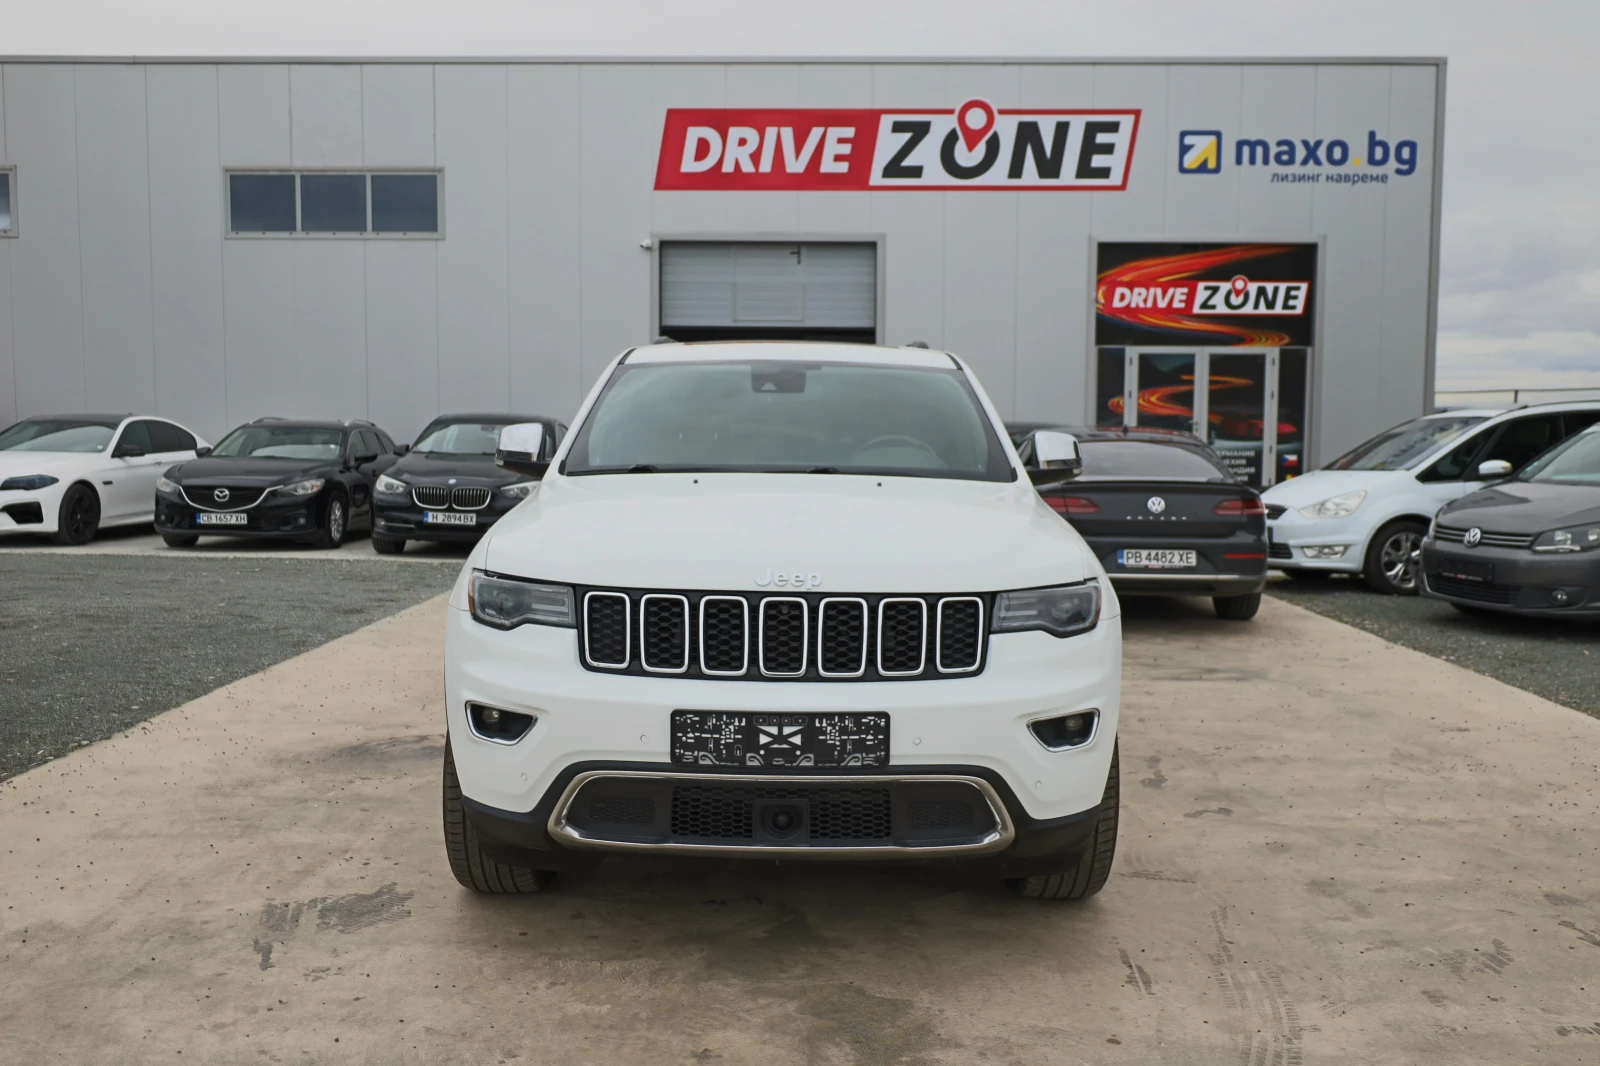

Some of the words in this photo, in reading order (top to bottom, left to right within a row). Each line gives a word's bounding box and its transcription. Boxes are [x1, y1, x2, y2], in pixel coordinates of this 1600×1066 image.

[680, 126, 856, 174] DRIVE
[881, 120, 1121, 180] ZONE
[1235, 130, 1418, 176] maxo.bg
[1270, 172, 1322, 183] лизинг
[1325, 172, 1389, 186] навреме
[1112, 287, 1189, 308] DRIVE
[1198, 285, 1302, 310] ZONE
[201, 514, 213, 523] CB
[215, 514, 233, 523] 1657
[235, 514, 246, 523] XH
[431, 513, 438, 522] H
[441, 513, 462, 523] 2894
[463, 514, 474, 524] BX
[1125, 551, 1143, 564] PB
[1145, 551, 1176, 564] 4482
[1178, 552, 1194, 565] XE
[755, 567, 822, 591] Jeep
